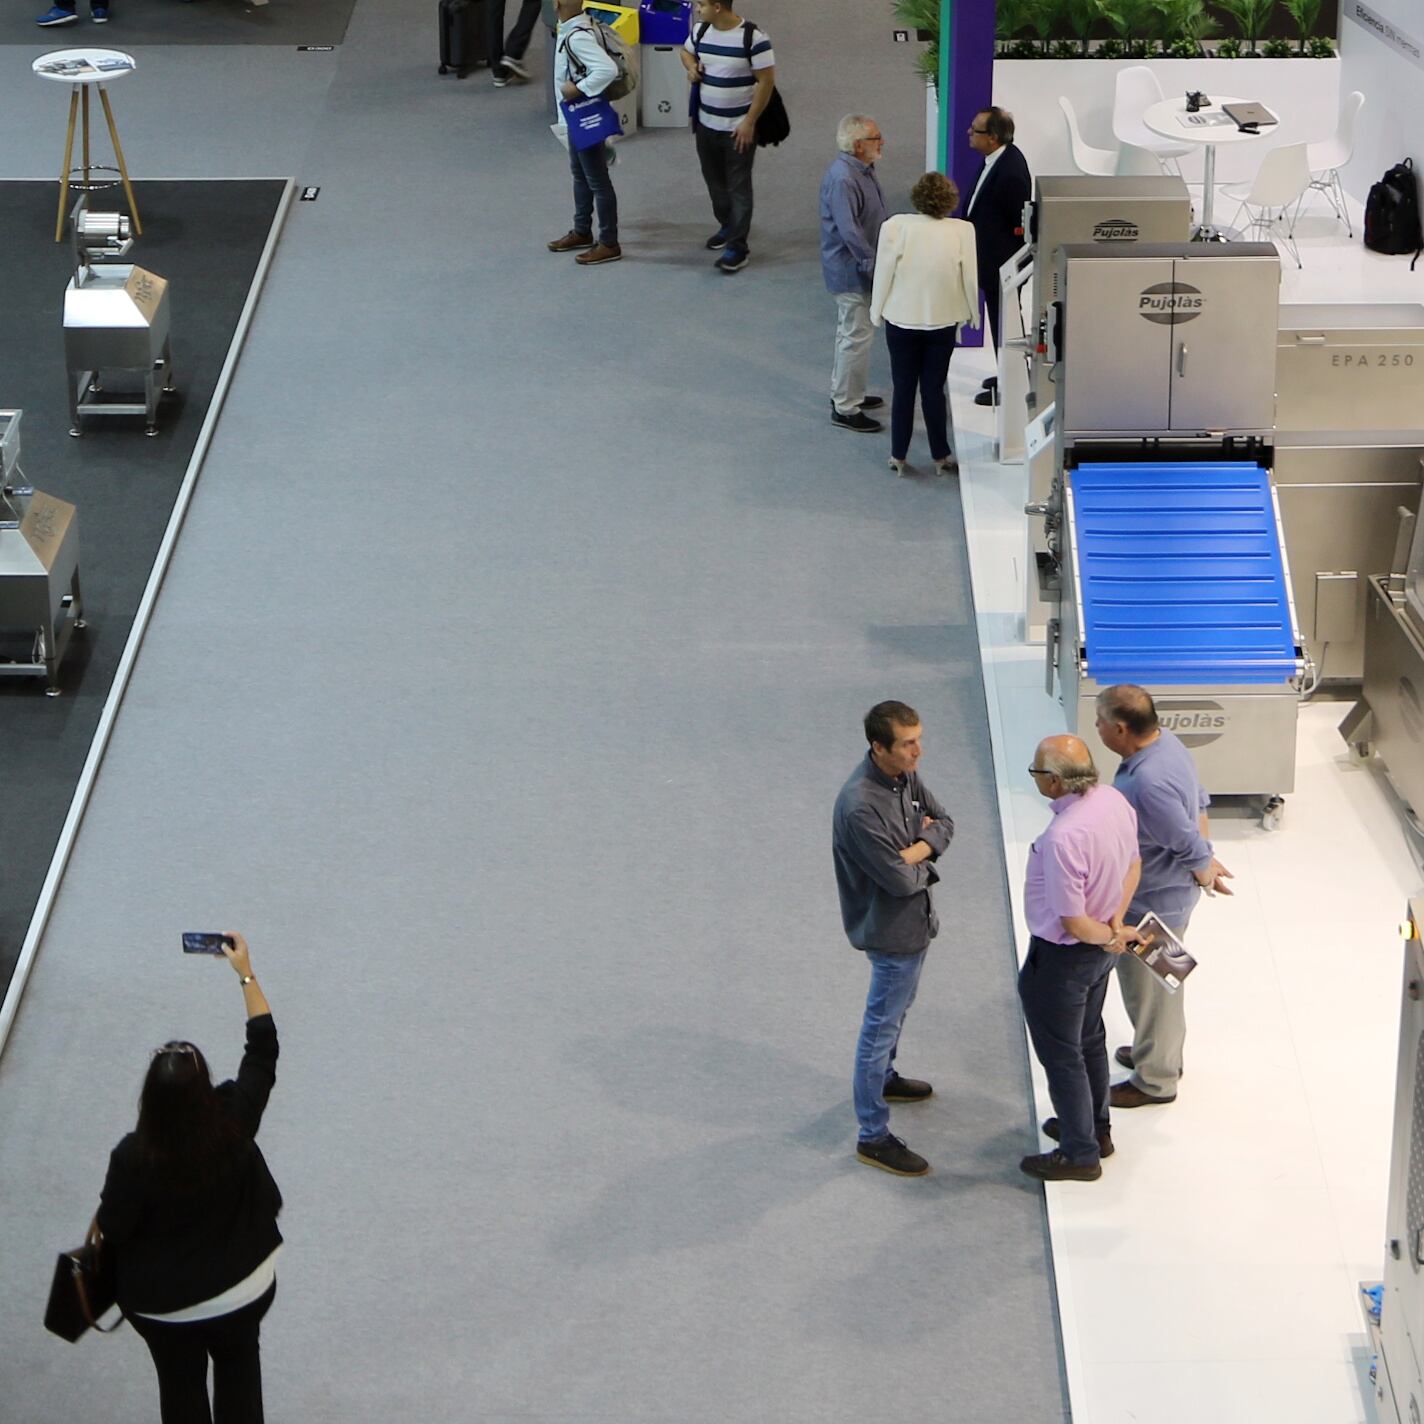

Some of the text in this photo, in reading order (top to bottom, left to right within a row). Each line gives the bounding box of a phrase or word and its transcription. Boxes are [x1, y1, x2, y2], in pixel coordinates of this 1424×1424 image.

[1092, 226, 1139, 240] Pujolàs
[1138, 295, 1203, 311] Pujolàs
[1330, 353, 1415, 367] EPA 250
[1159, 712, 1225, 731] ujolàs
